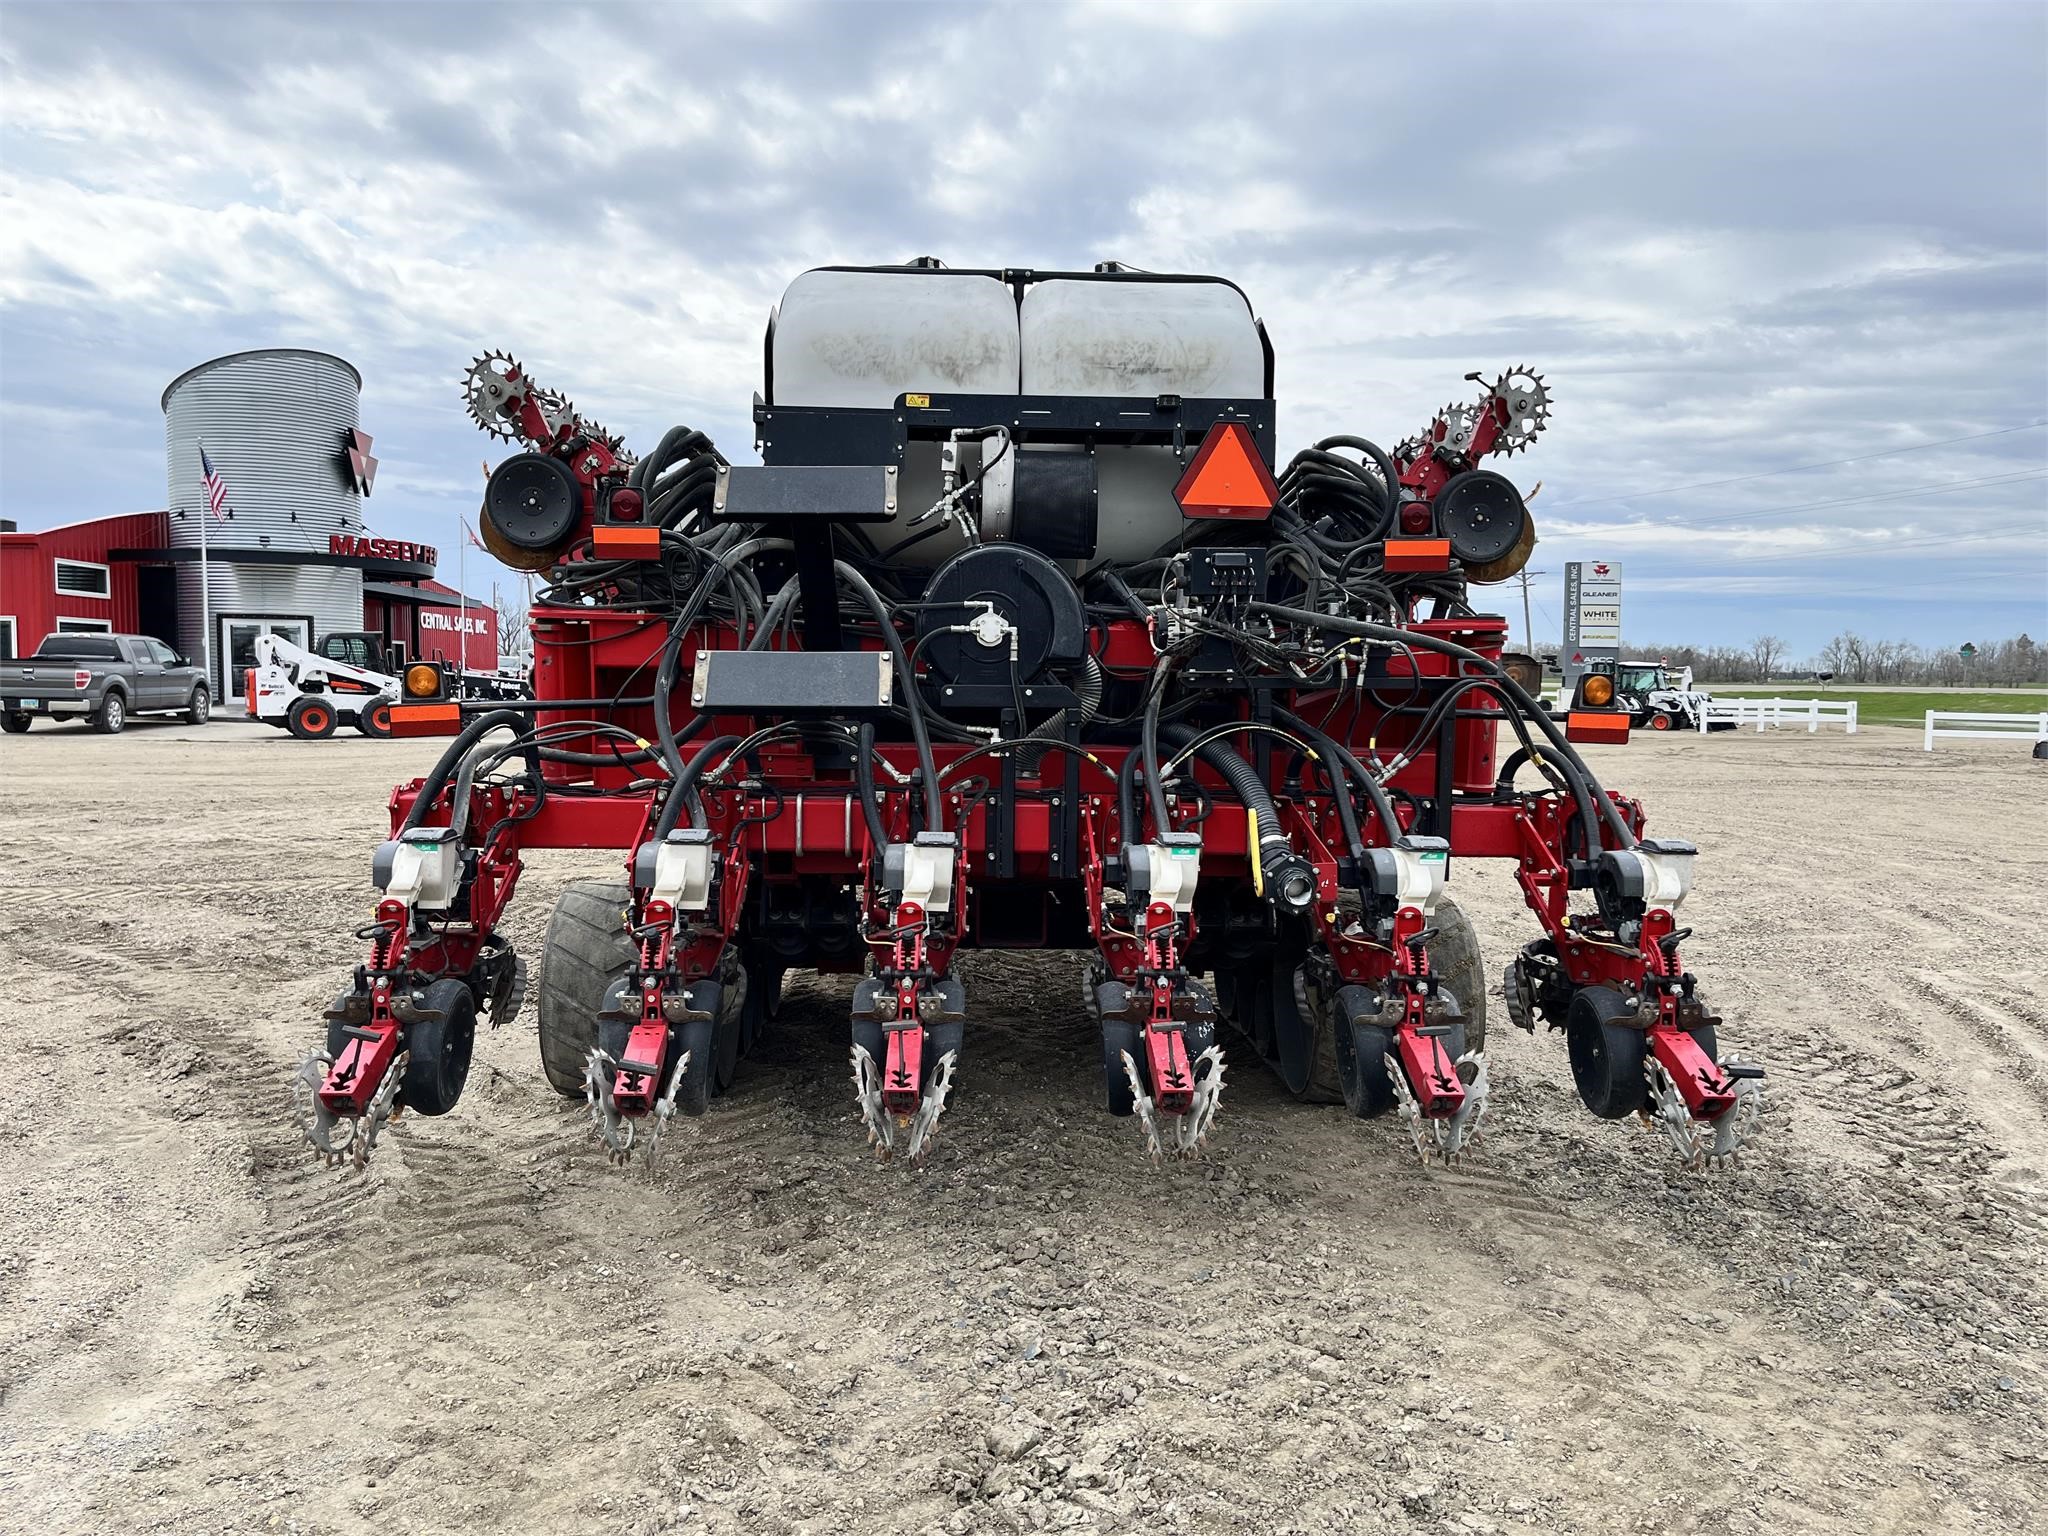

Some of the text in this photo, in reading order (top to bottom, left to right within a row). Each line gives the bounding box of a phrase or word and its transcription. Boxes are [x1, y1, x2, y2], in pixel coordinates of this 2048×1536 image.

[328, 535, 420, 562] MASSEY
[1570, 564, 1578, 580] INC.
[420, 612, 453, 631] CENTRAL
[475, 619, 488, 634] INC.
[1569, 607, 1577, 642] CENTRAL
[500, 681, 521, 690] Bobcat
